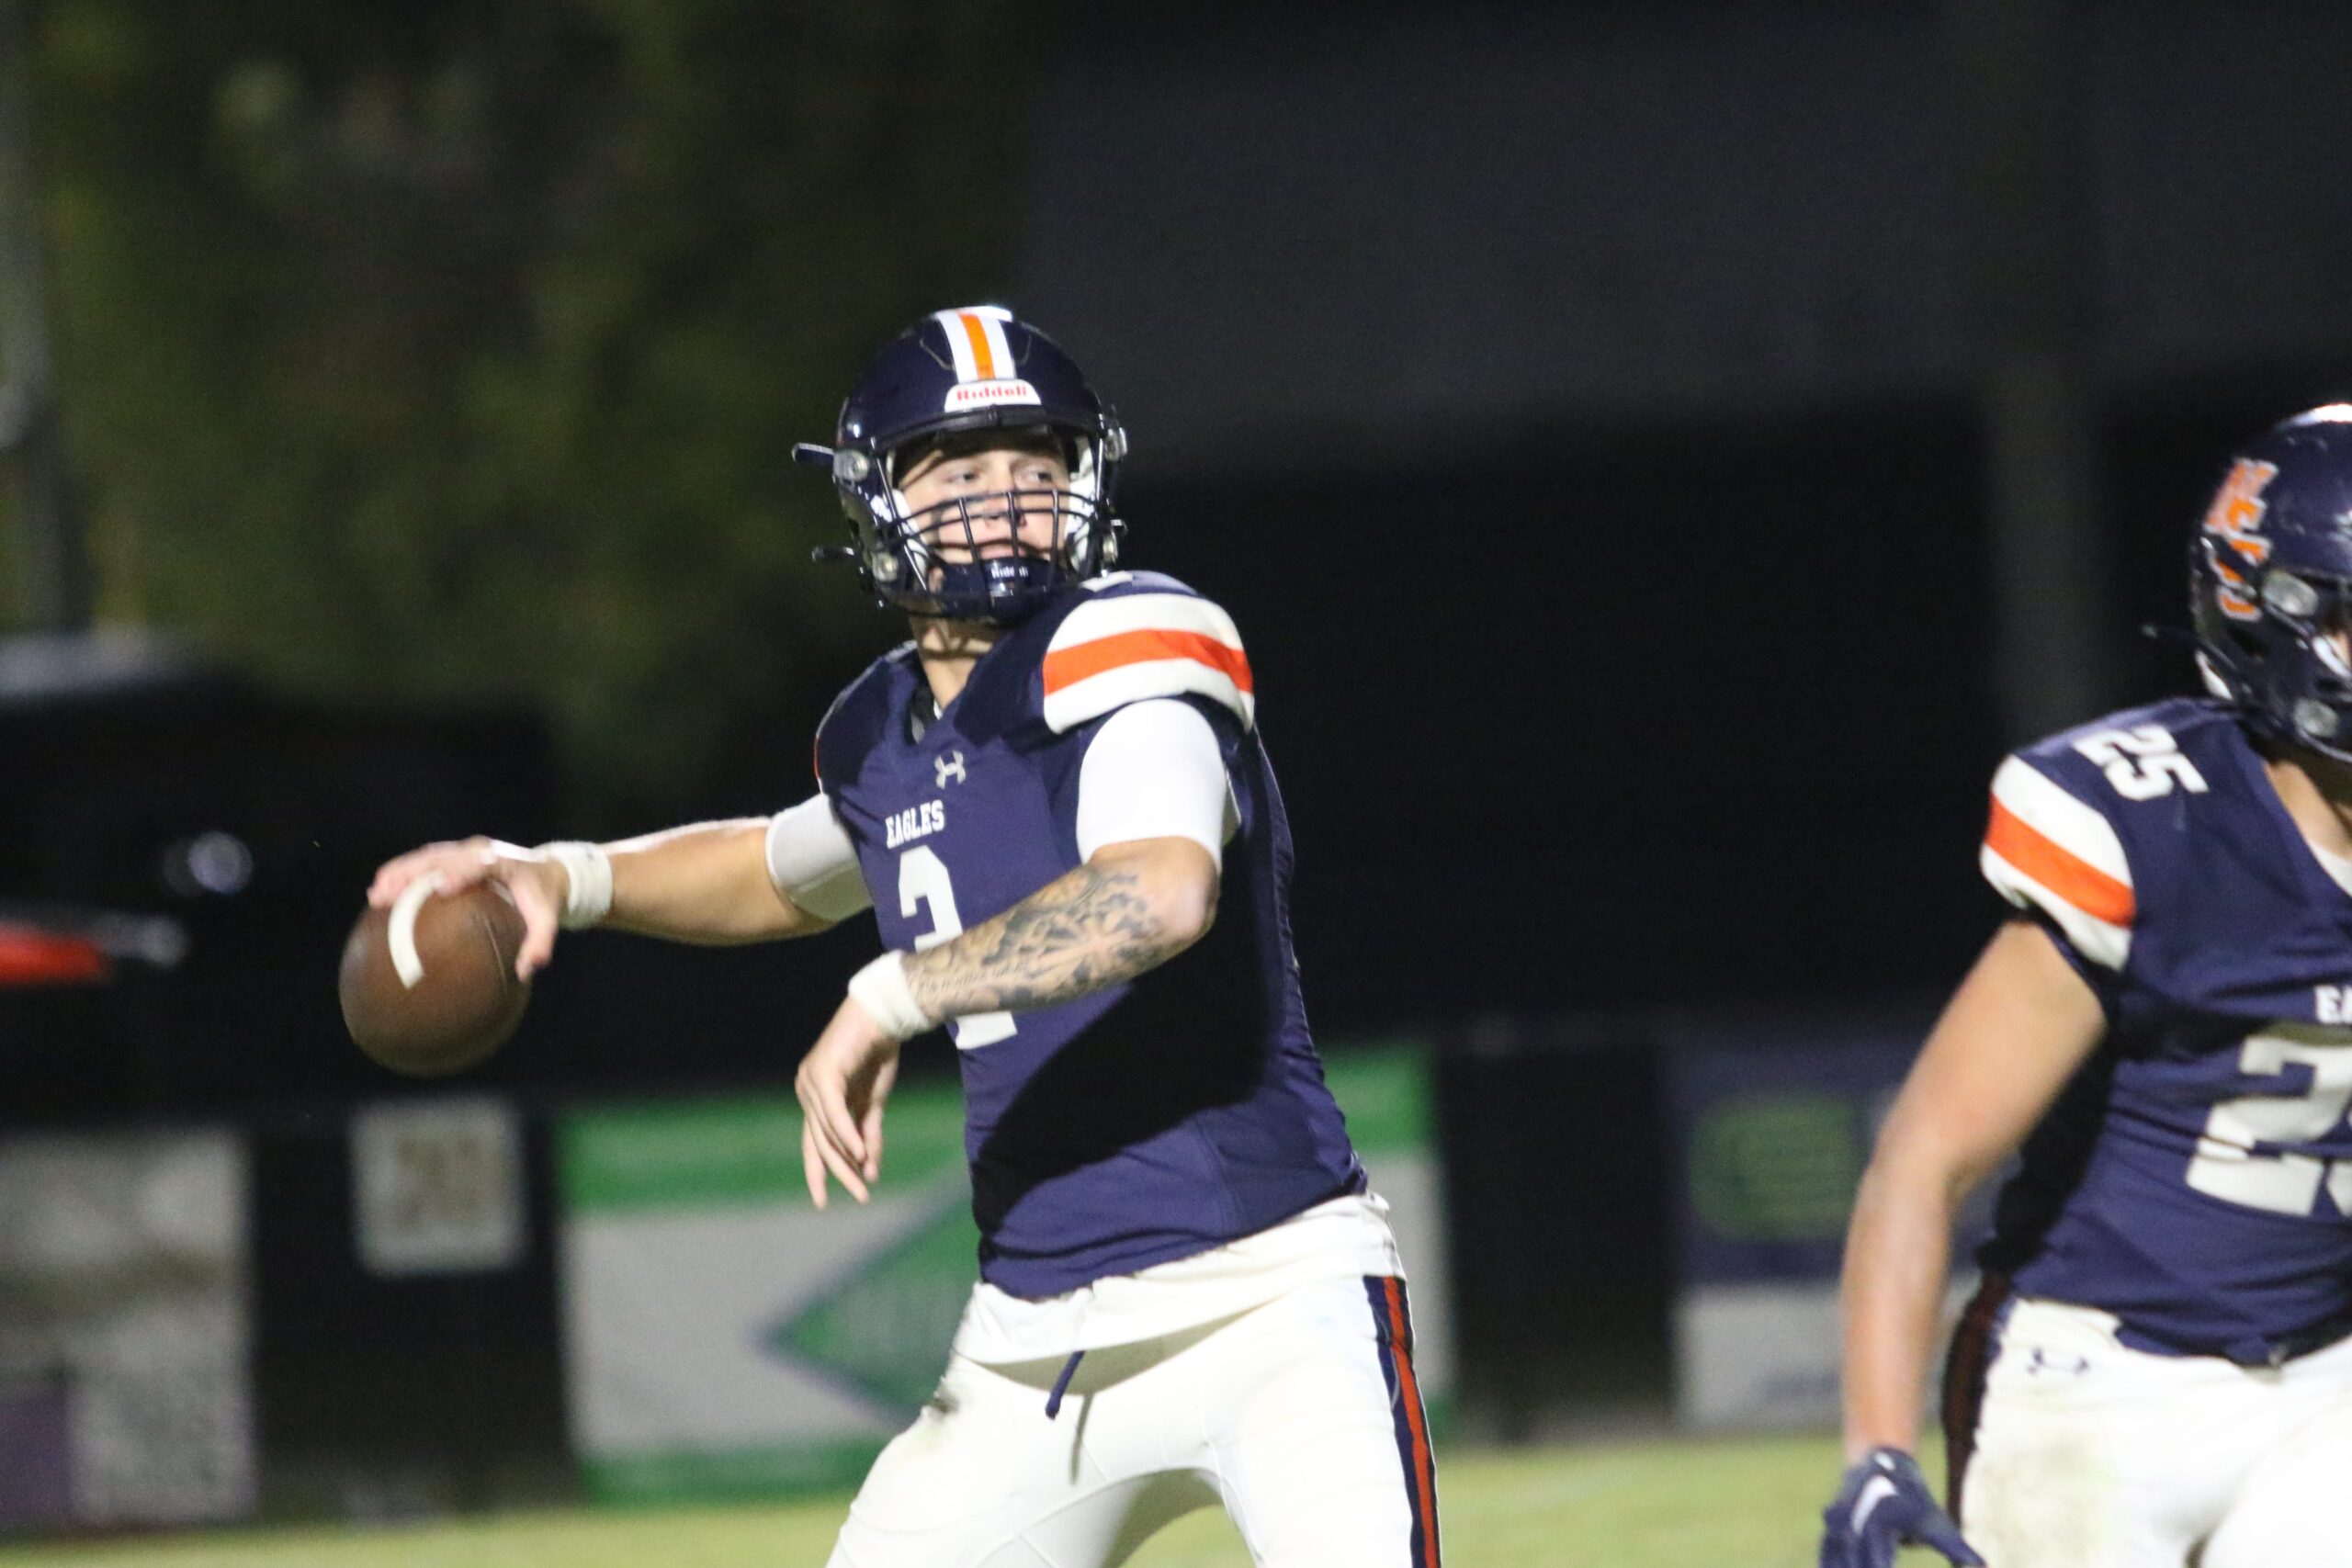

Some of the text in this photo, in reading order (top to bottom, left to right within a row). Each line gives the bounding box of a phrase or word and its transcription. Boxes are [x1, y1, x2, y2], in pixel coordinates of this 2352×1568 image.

[956, 385, 1027, 401] Riddell
[2073, 723, 2210, 802] 25
[885, 799, 944, 850] EAGLES
[898, 844, 1018, 1051] 2
[2185, 1035, 2352, 1218] 2
